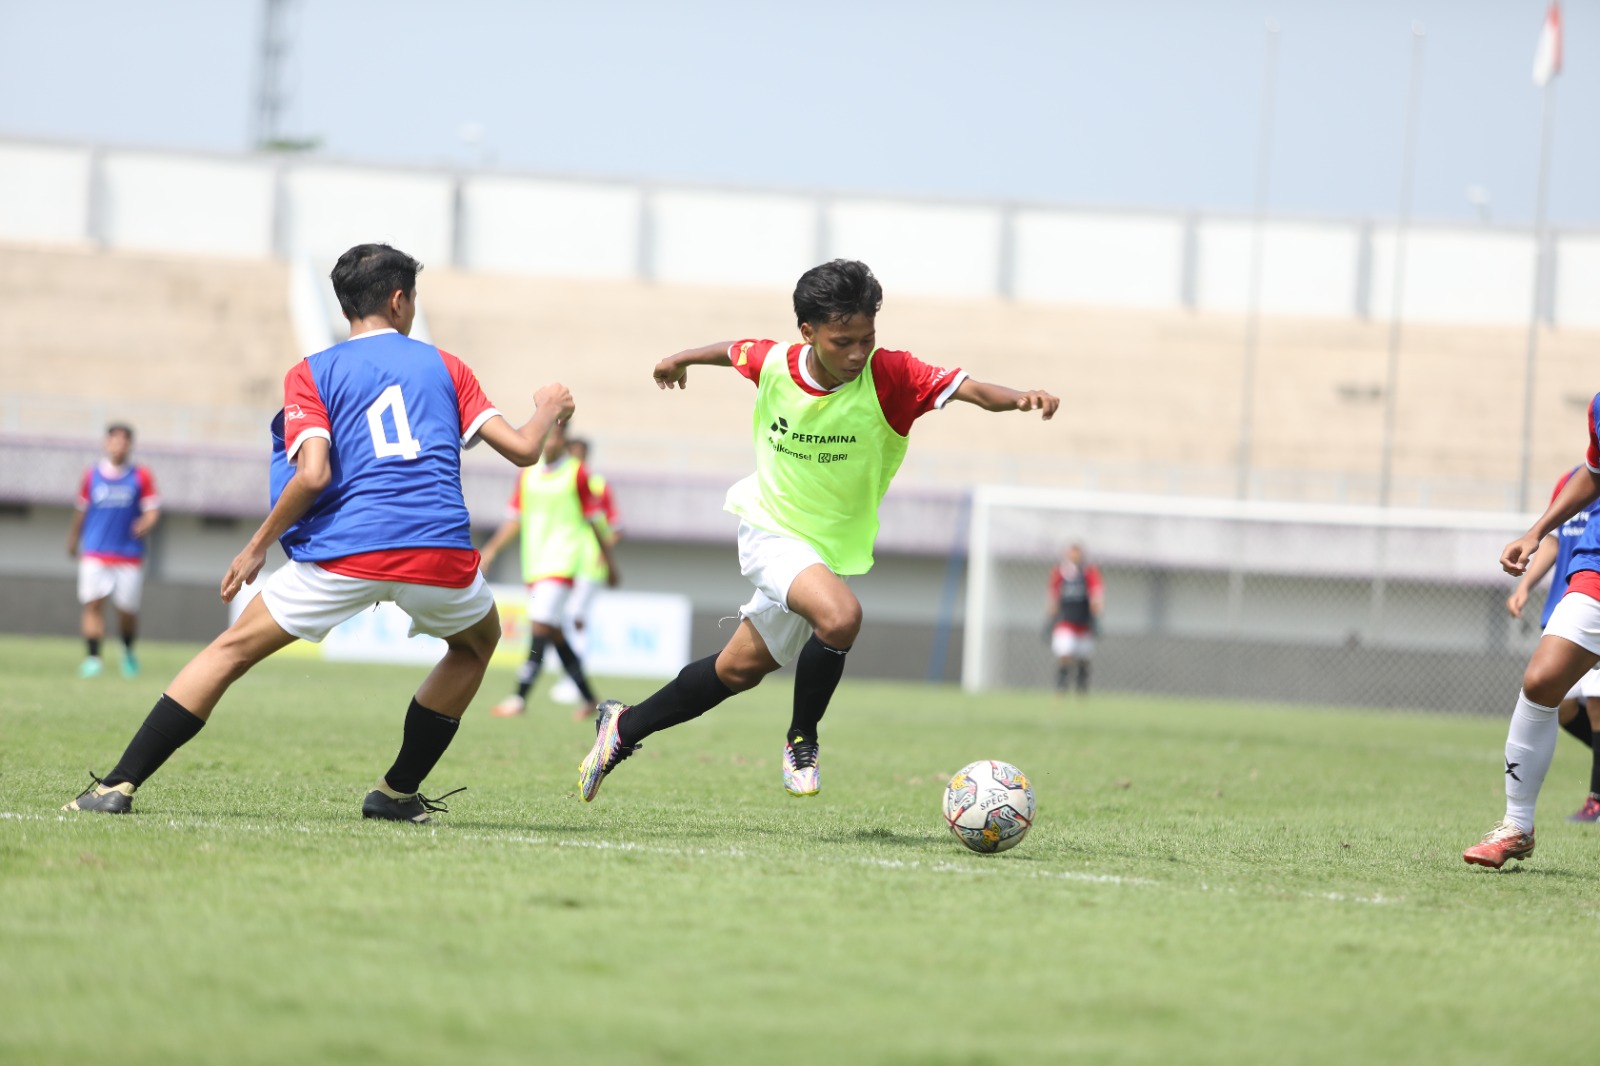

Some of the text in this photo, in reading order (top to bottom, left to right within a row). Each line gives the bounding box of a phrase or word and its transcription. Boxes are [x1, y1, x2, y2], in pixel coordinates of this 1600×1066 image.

[366, 384, 421, 460] 4
[792, 432, 857, 444] PERTAMINA
[832, 453, 848, 462] BRI
[980, 792, 1009, 811] SPECS
